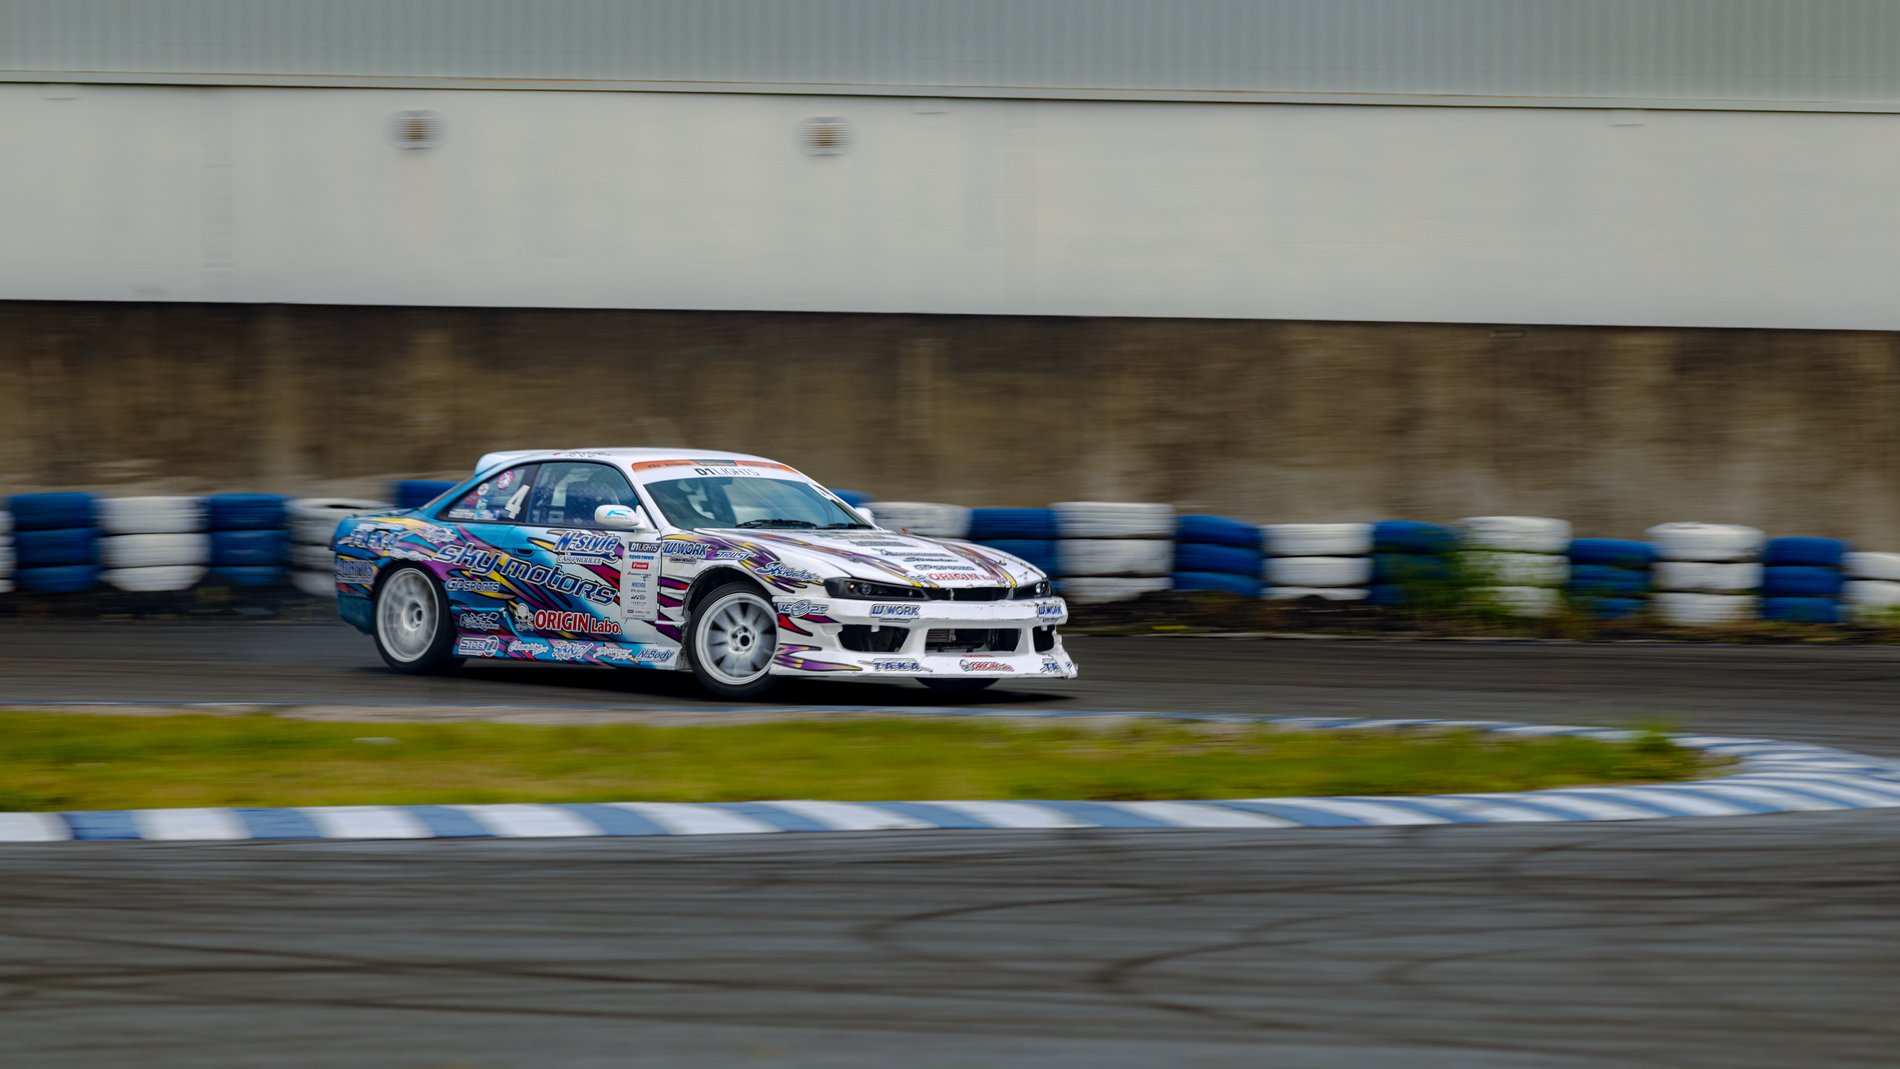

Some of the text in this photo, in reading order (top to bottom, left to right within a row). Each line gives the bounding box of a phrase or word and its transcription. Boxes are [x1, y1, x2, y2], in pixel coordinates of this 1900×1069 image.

[505, 484, 531, 519] 4
[554, 531, 620, 552] N-style
[535, 610, 622, 635] ORIGIN Labo.
